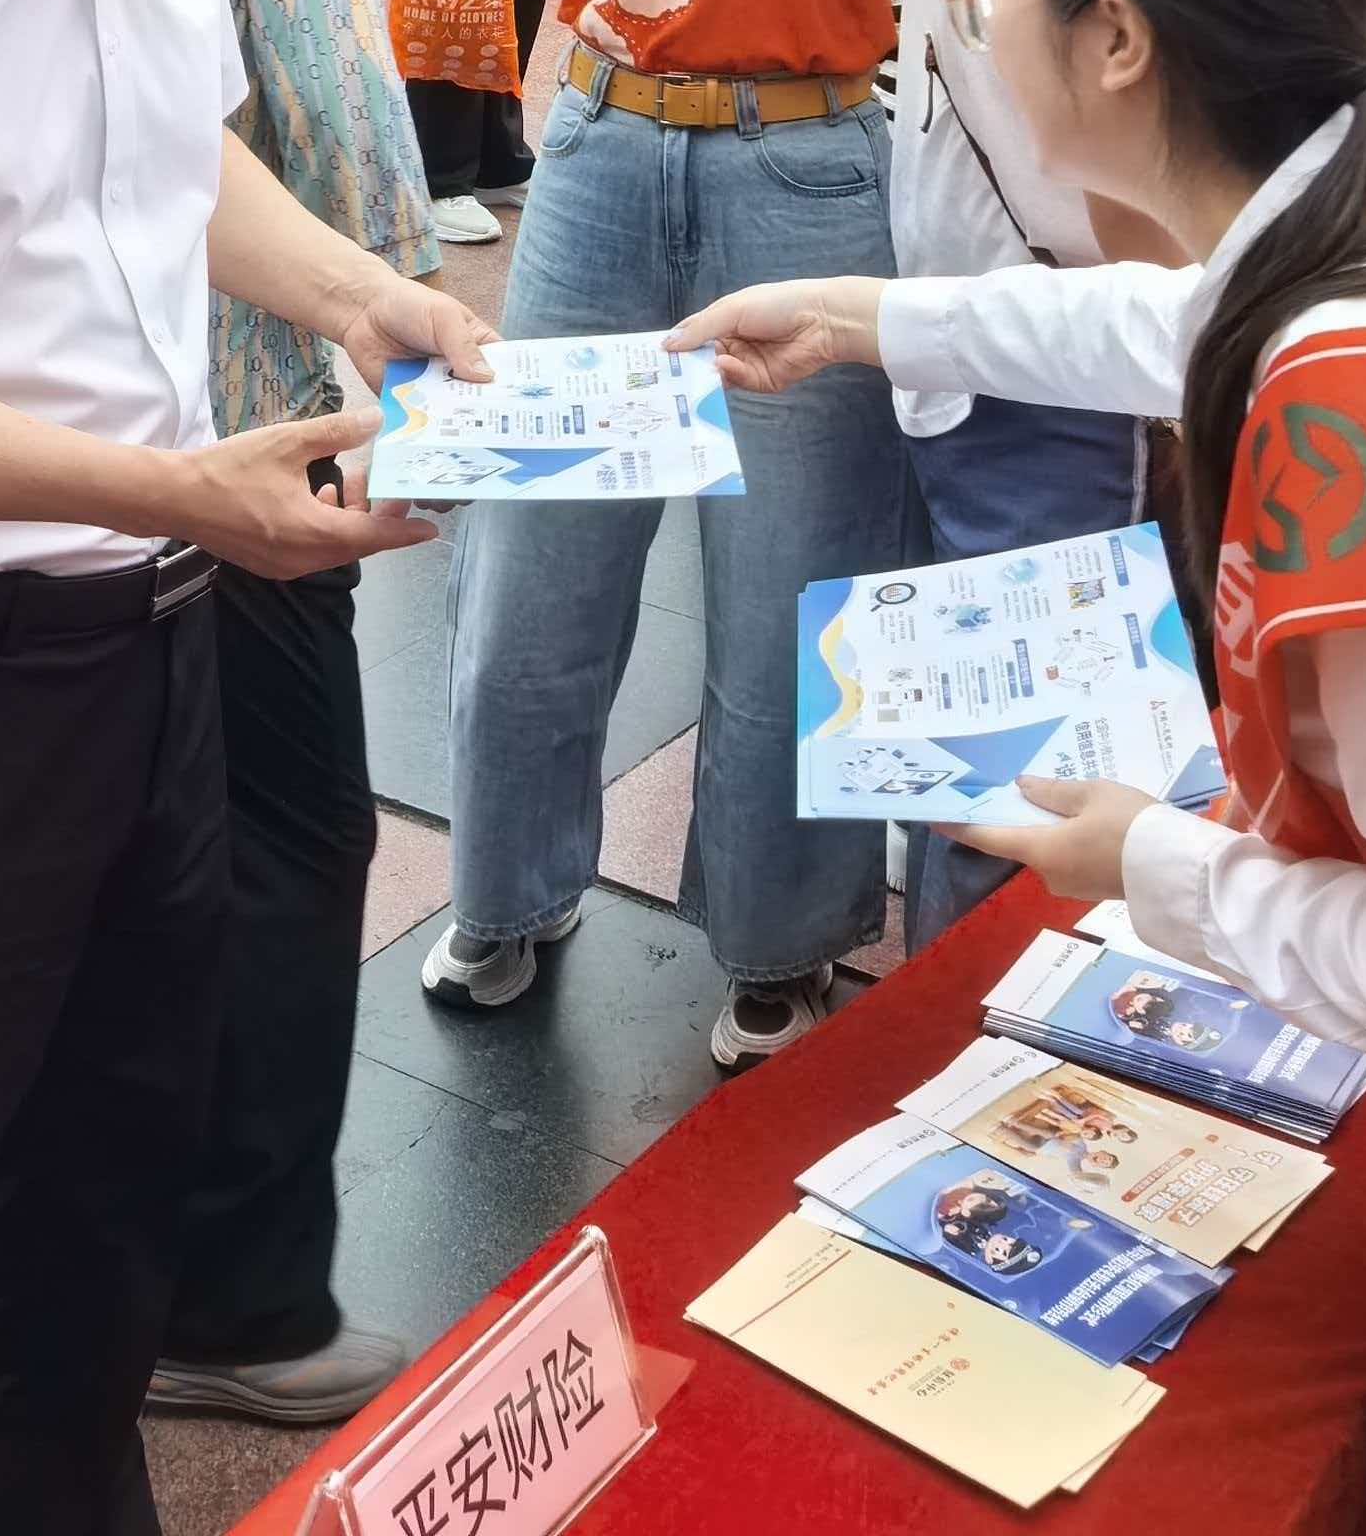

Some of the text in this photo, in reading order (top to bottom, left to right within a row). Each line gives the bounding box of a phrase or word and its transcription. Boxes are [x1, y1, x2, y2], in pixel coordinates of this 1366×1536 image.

[403, 6, 505, 24] HOME OF CLOTHES
[391, 1328, 605, 1536] 平安财险
